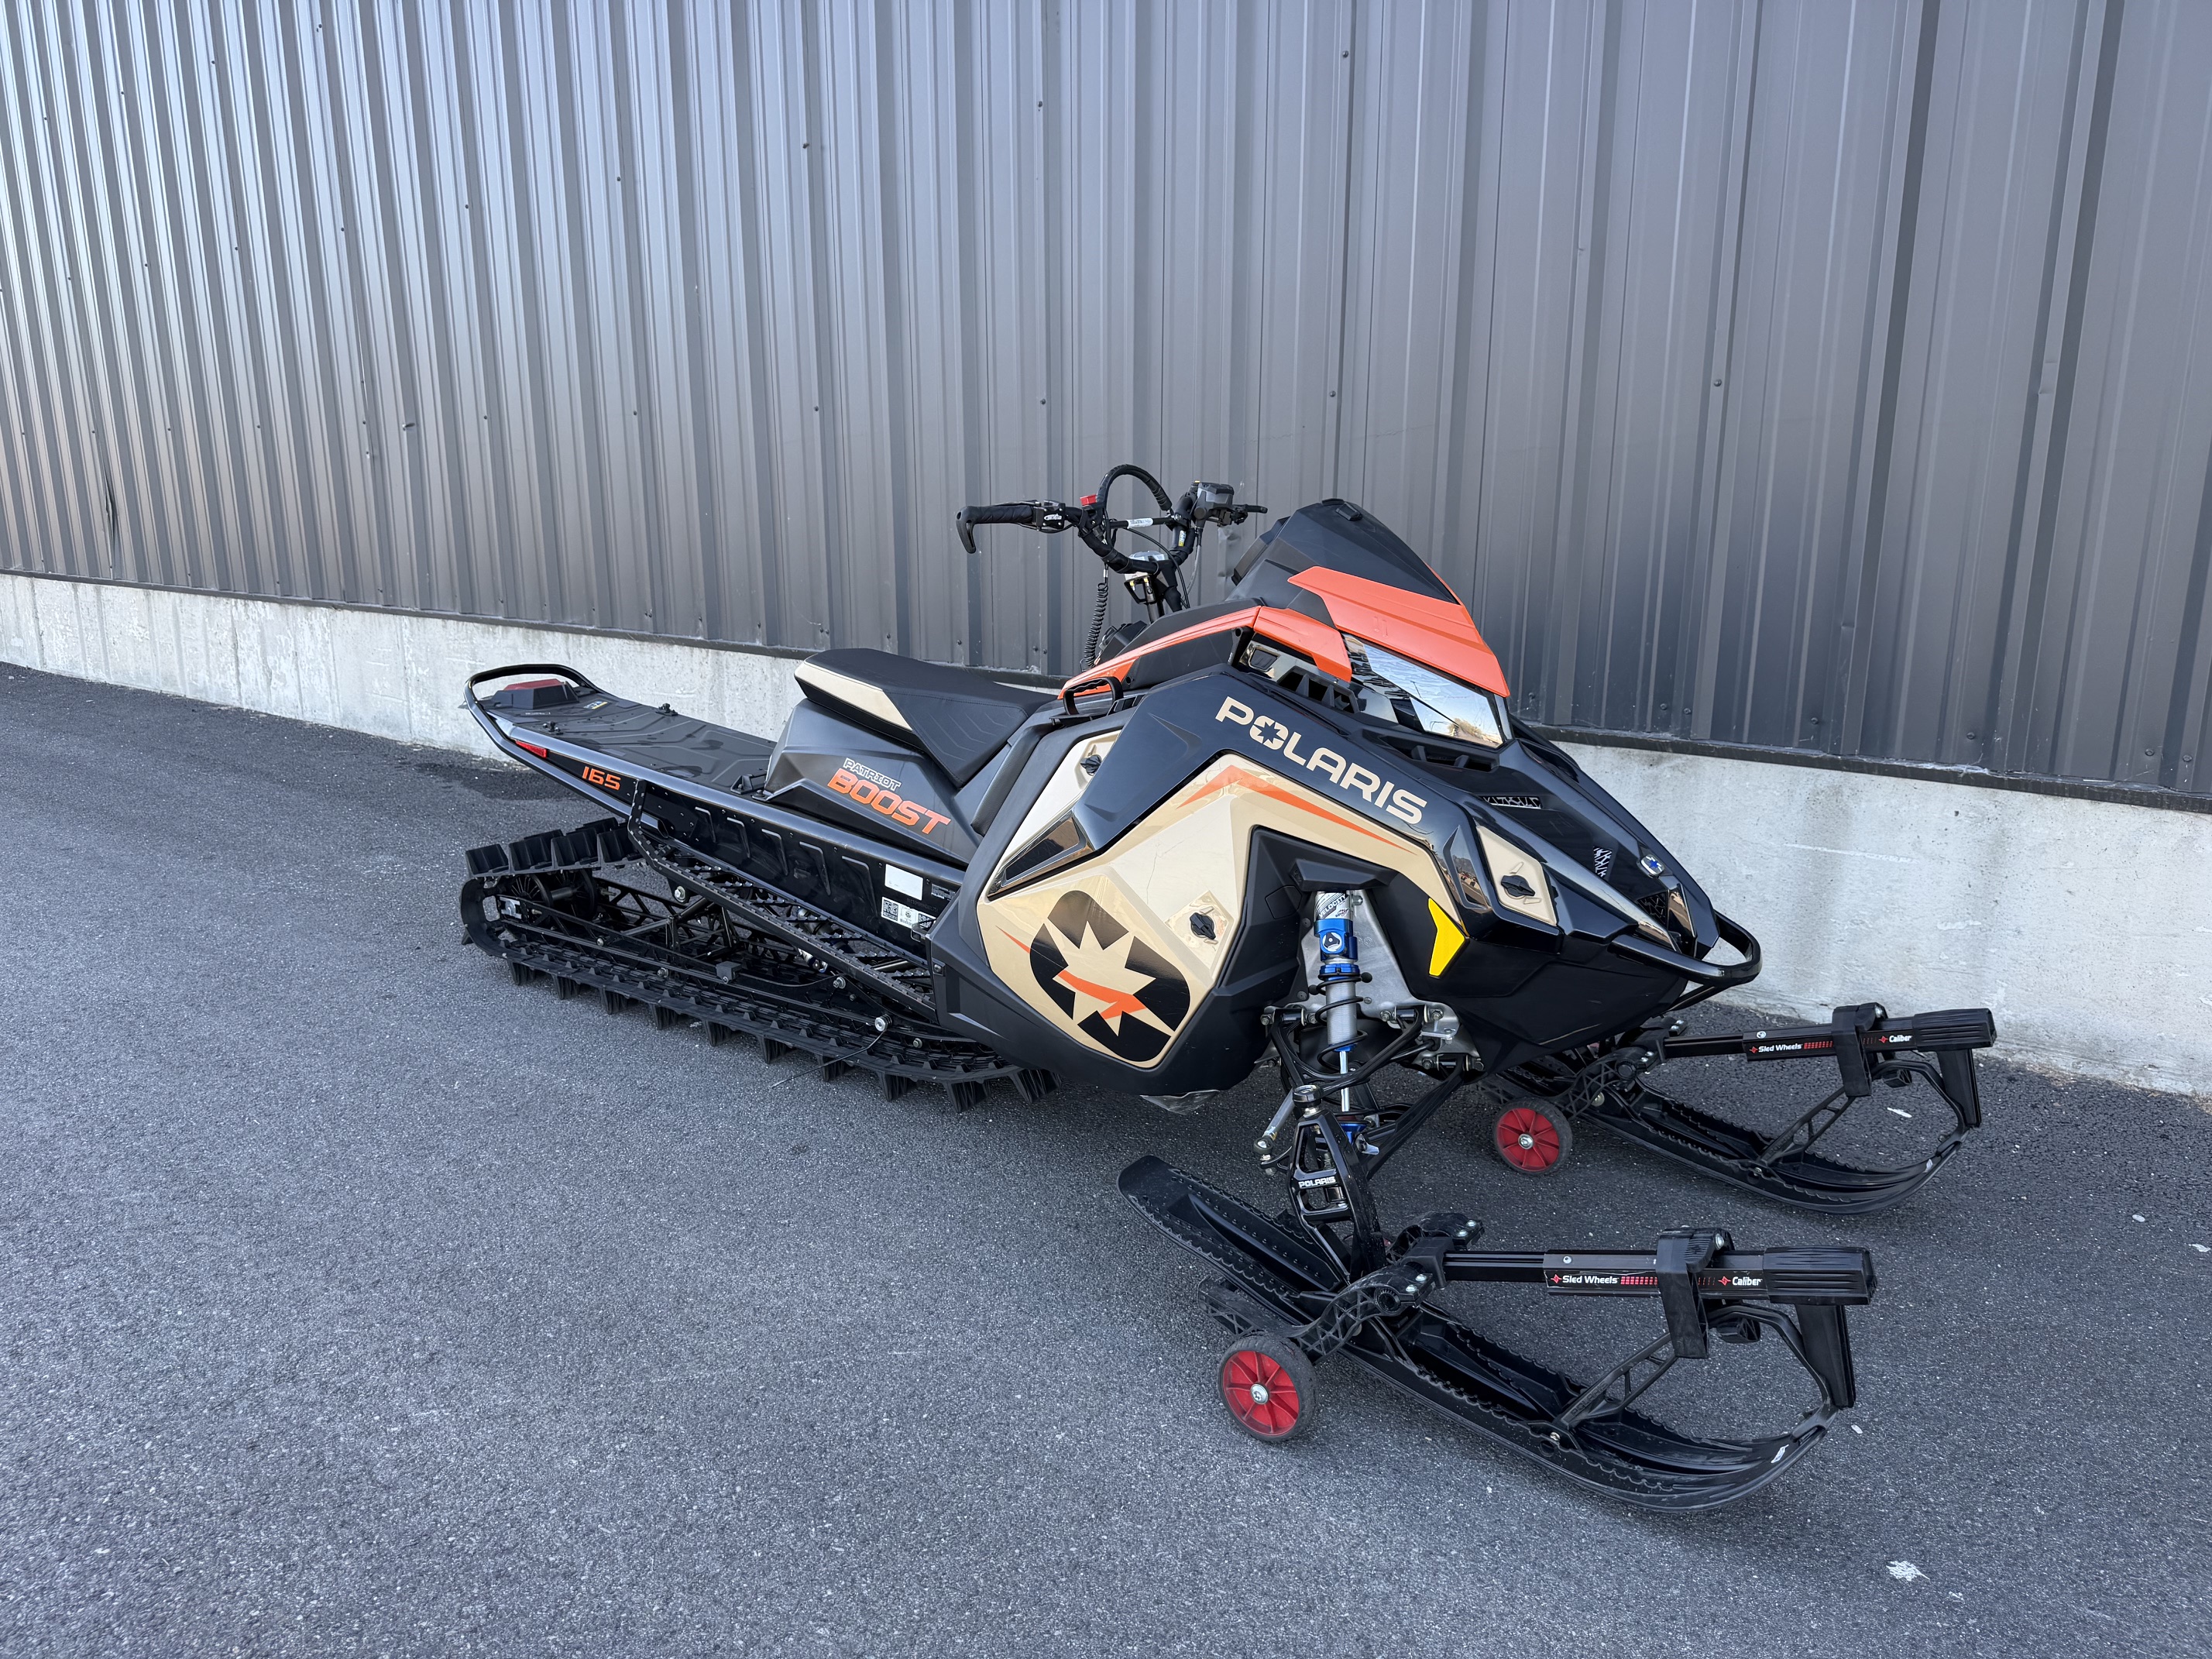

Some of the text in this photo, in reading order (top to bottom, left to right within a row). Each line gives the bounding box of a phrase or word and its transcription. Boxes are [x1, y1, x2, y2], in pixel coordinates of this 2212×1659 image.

[1214, 696, 1427, 825] POLARIS
[582, 766, 621, 790] 165
[843, 757, 902, 792] PATRIOT
[827, 768, 952, 835] BOOST
[1318, 893, 1346, 919] VELOCITY
[1776, 1043, 1802, 1052] Wheels
[1888, 1035, 1912, 1043] Caliber
[1298, 1176, 1336, 1189] POLARIS
[1562, 1275, 1619, 1284] Sled Wheels
[1732, 1276, 1762, 1286] Caliber
